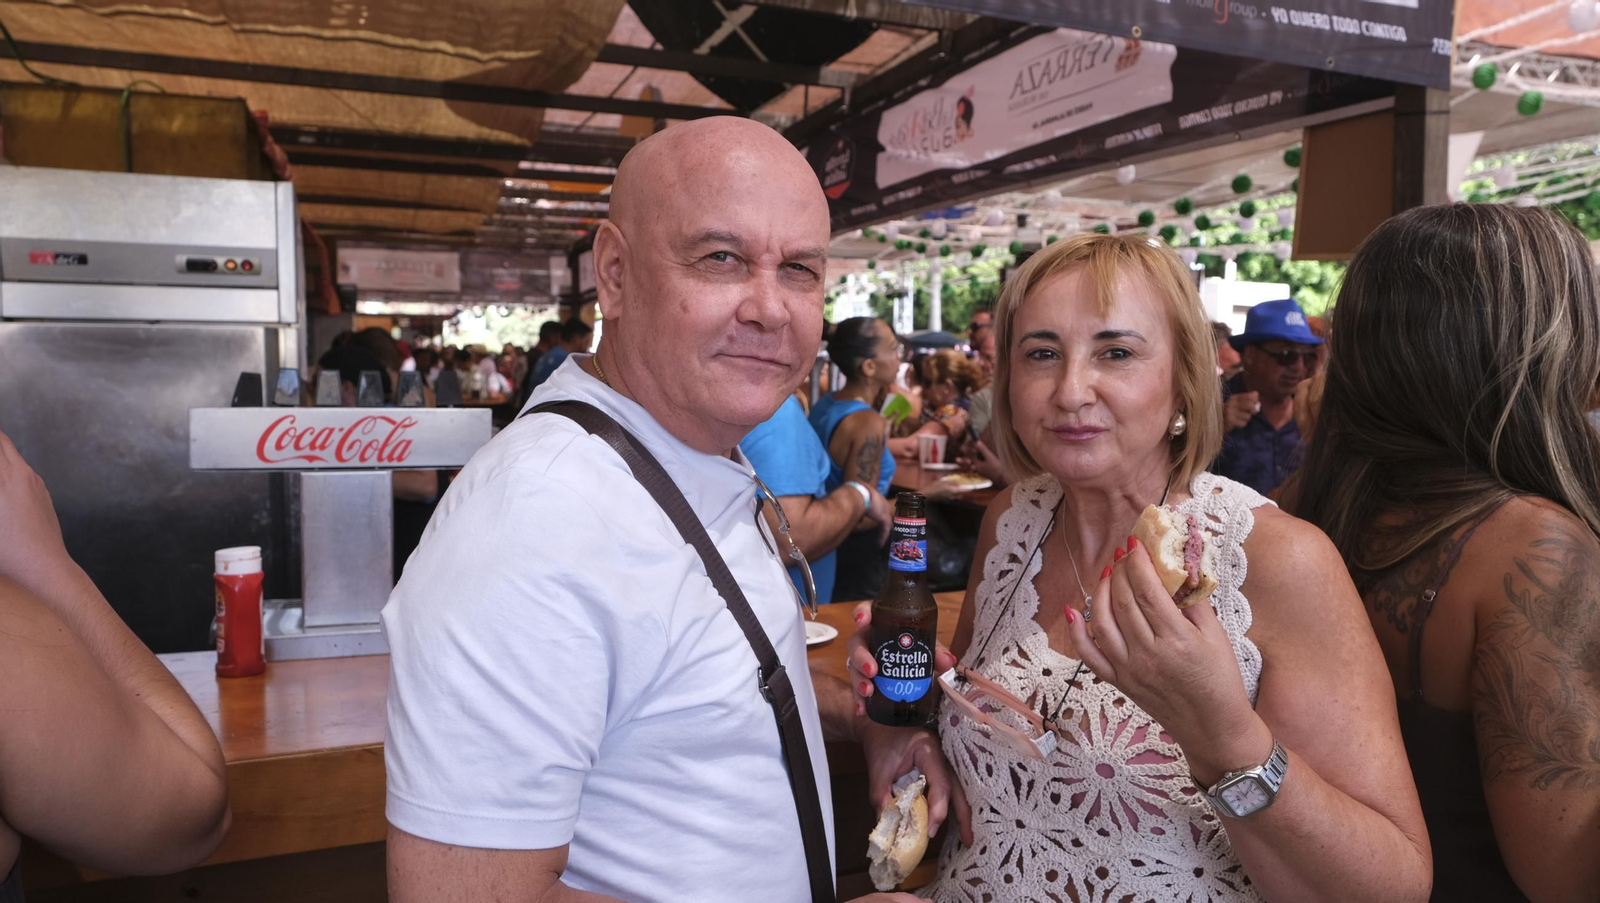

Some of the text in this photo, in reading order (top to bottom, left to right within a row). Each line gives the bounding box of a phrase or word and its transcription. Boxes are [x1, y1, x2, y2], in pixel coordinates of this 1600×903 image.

[1271, 6, 1289, 24] YO
[1289, 9, 1330, 31] QUIERO
[1331, 15, 1360, 35] TODO
[1361, 20, 1407, 42] CONTIGO
[256, 414, 418, 464] Coca-Cola
[881, 648, 928, 664] Estrella
[882, 662, 926, 678] Galicia
[894, 681, 914, 696] 0,0
